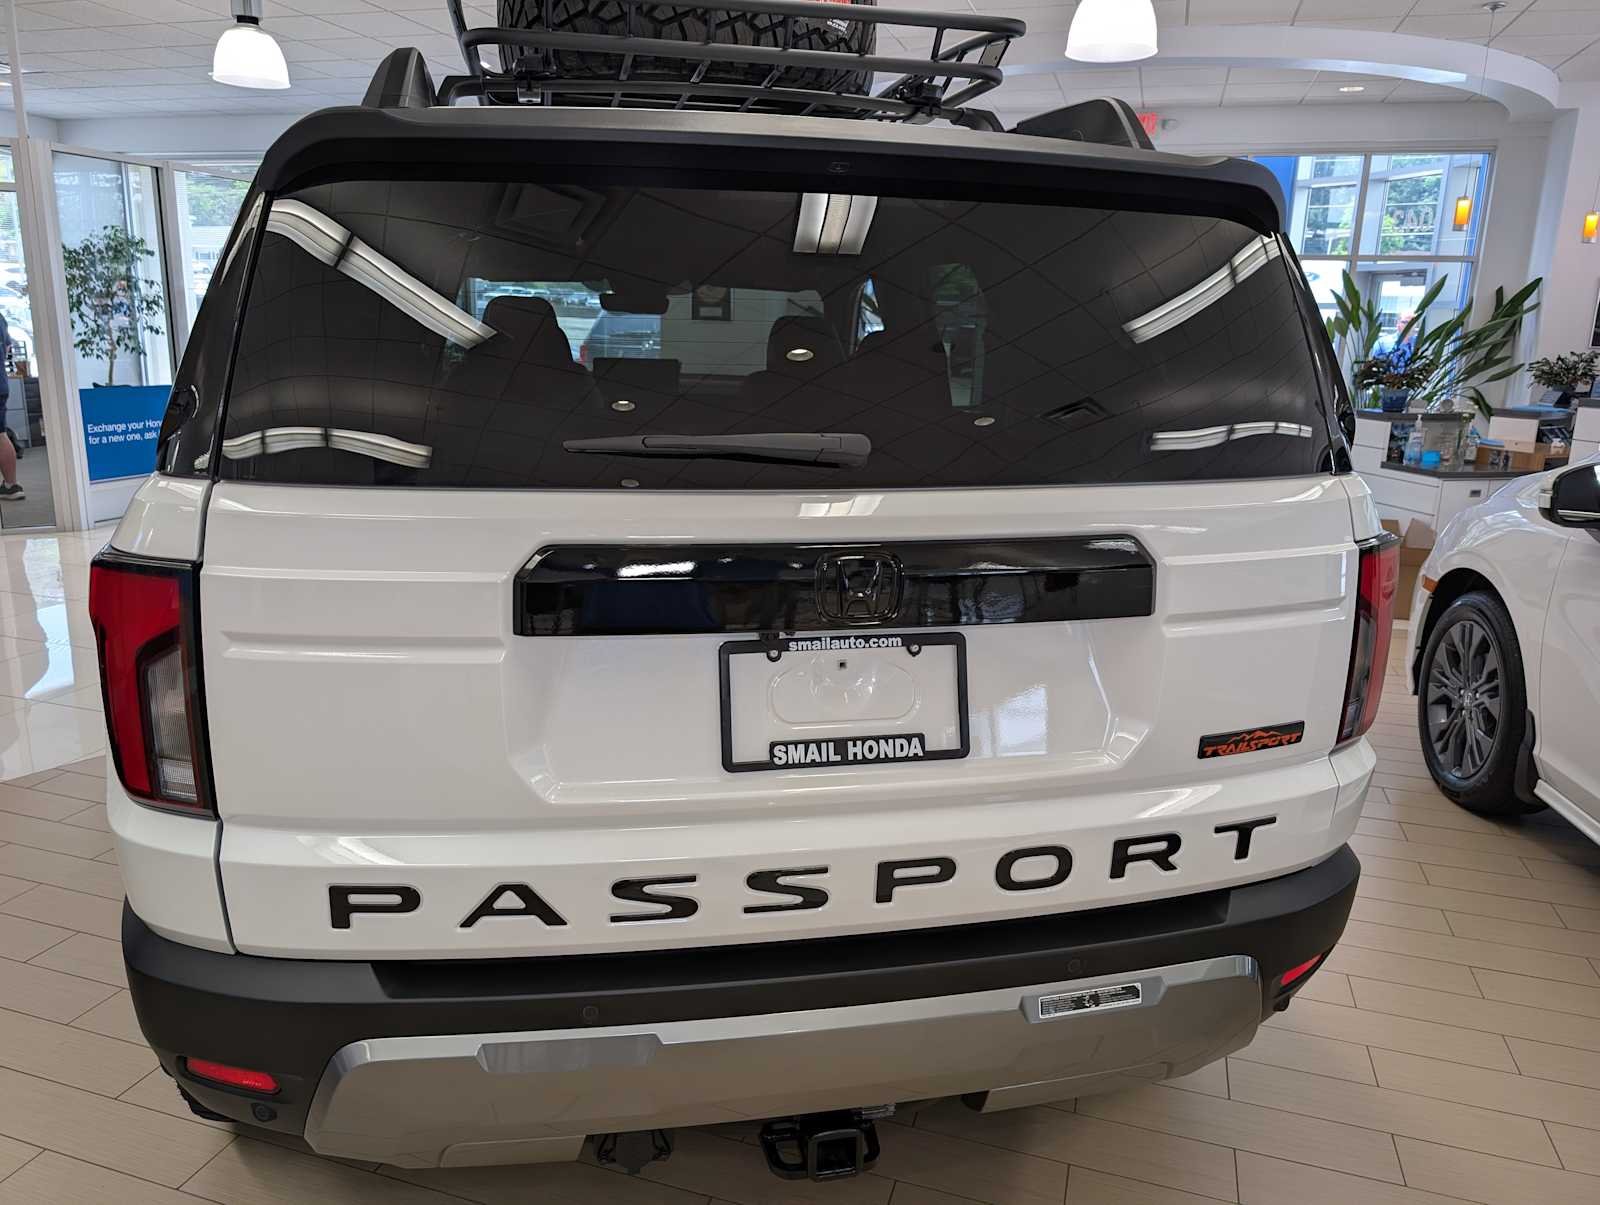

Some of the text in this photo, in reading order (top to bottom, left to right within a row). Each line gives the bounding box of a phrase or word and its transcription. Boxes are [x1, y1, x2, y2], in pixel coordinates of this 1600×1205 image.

[87, 423, 126, 433] Exchange
[127, 422, 144, 432] your
[89, 436, 100, 445] for
[108, 434, 125, 443] new
[144, 430, 157, 439] ask
[788, 636, 902, 651] smailauto.com
[773, 737, 924, 766] SMAIL HONDA
[1203, 733, 1302, 756] TRAILSPORT
[329, 816, 1277, 930] PASSPORT
